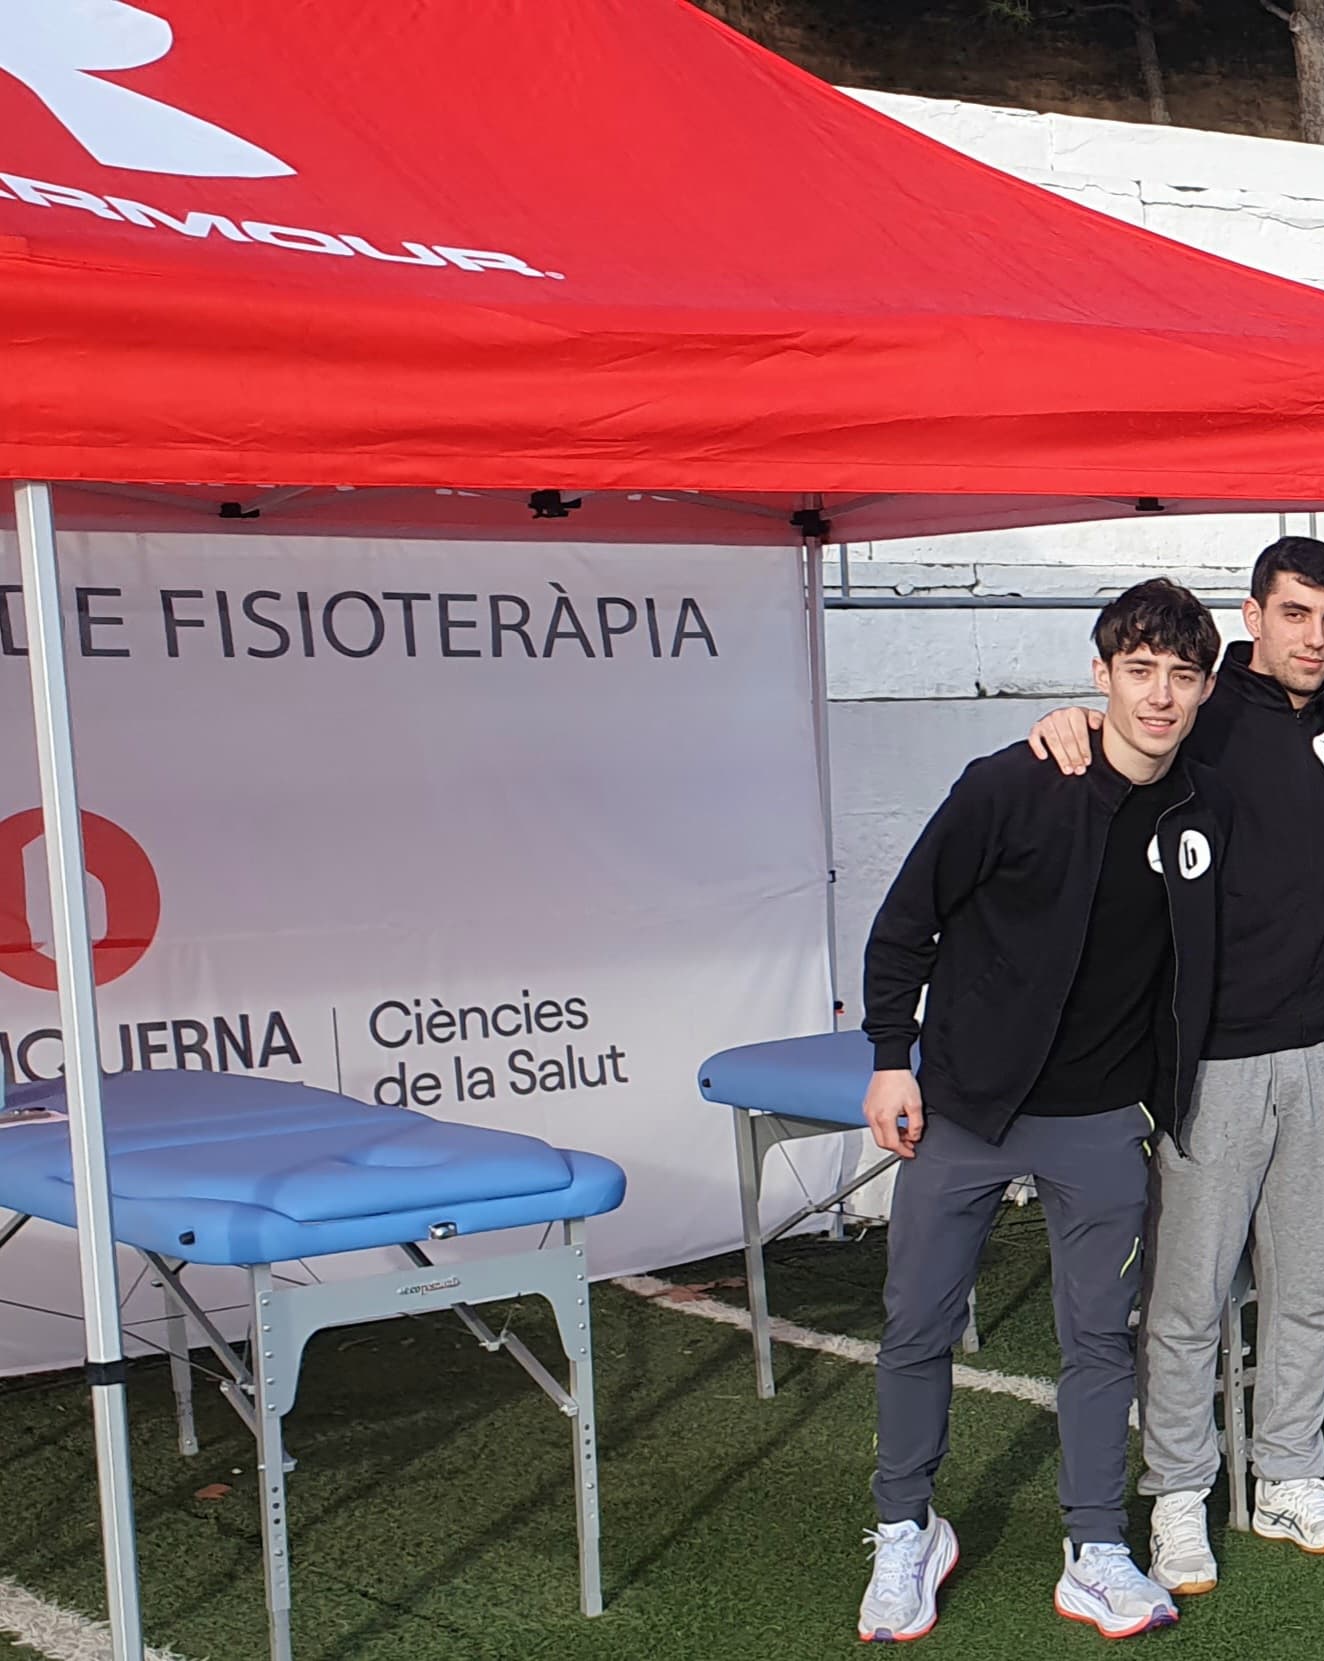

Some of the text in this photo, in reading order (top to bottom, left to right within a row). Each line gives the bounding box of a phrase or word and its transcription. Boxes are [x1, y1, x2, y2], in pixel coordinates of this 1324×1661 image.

[0, 171, 545, 278] RMOUR
[160, 582, 719, 659] FISIOTERÀPIA
[369, 989, 590, 1049] Ciències
[374, 1044, 629, 1108] de la Salut
